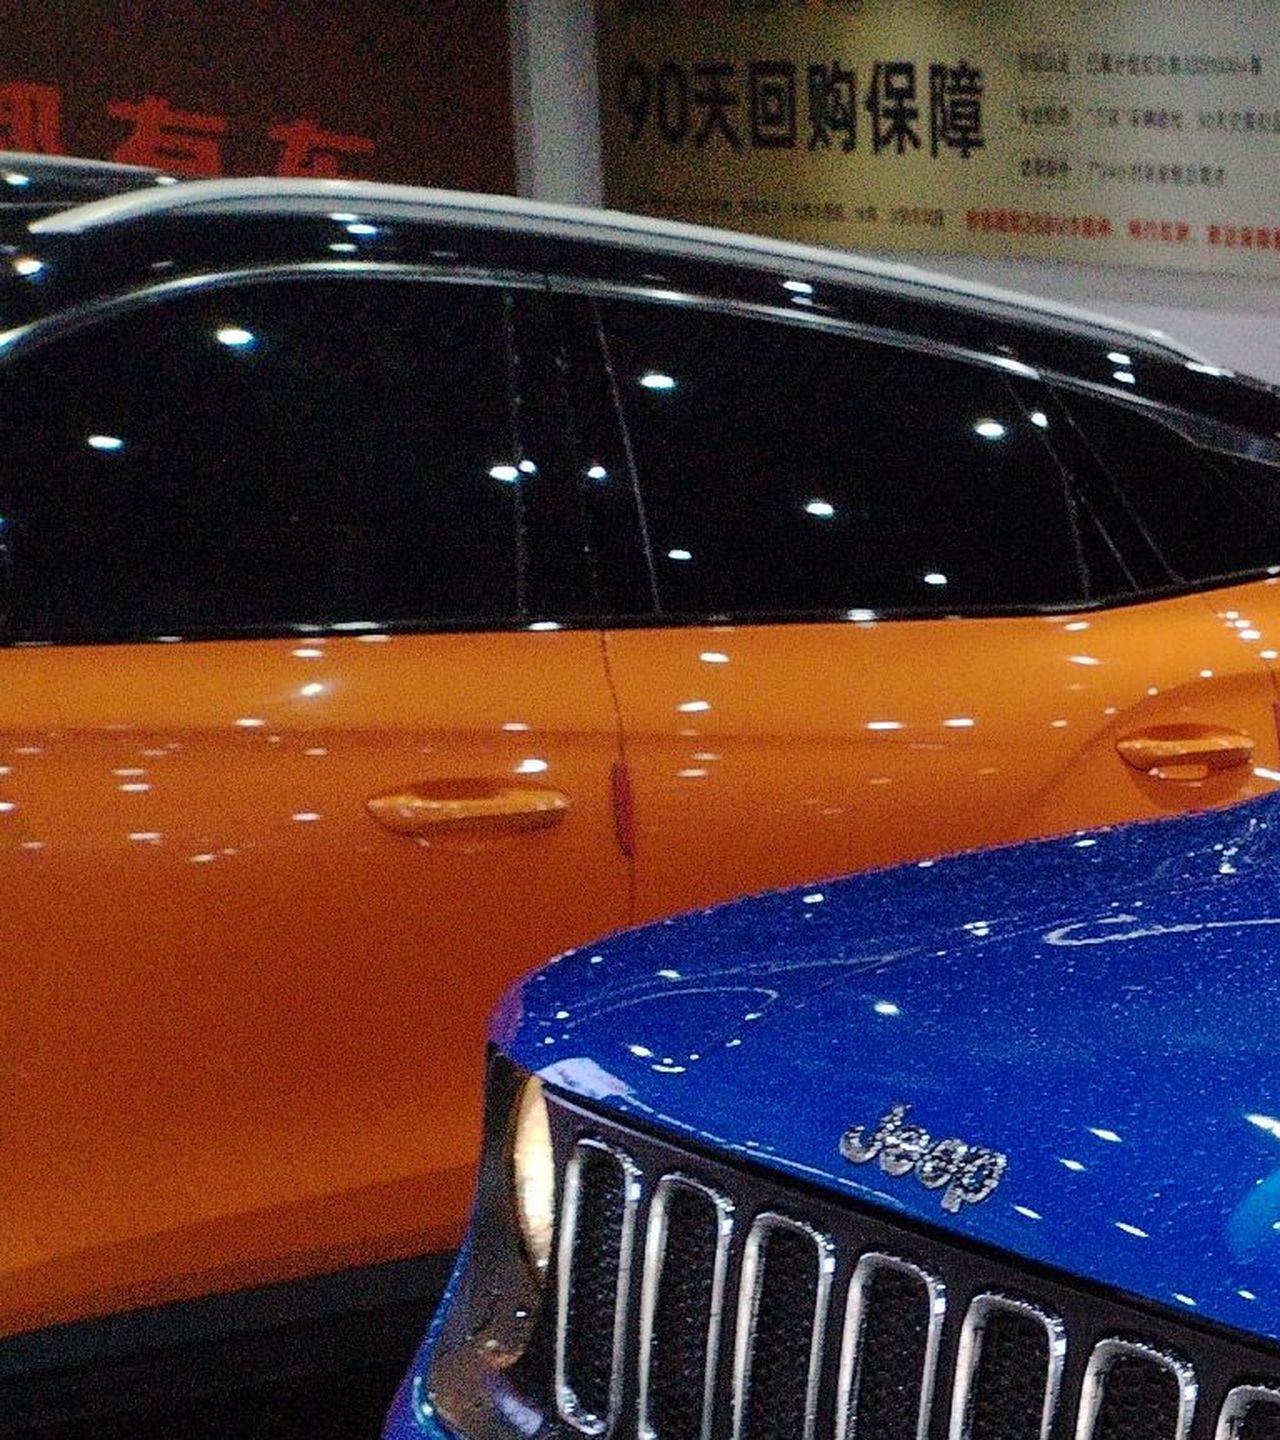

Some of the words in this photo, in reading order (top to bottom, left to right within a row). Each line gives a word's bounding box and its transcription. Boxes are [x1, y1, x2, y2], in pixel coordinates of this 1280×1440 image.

[622, 58, 988, 161] 90天回购保障
[838, 1103, 1008, 1214] Jeep
